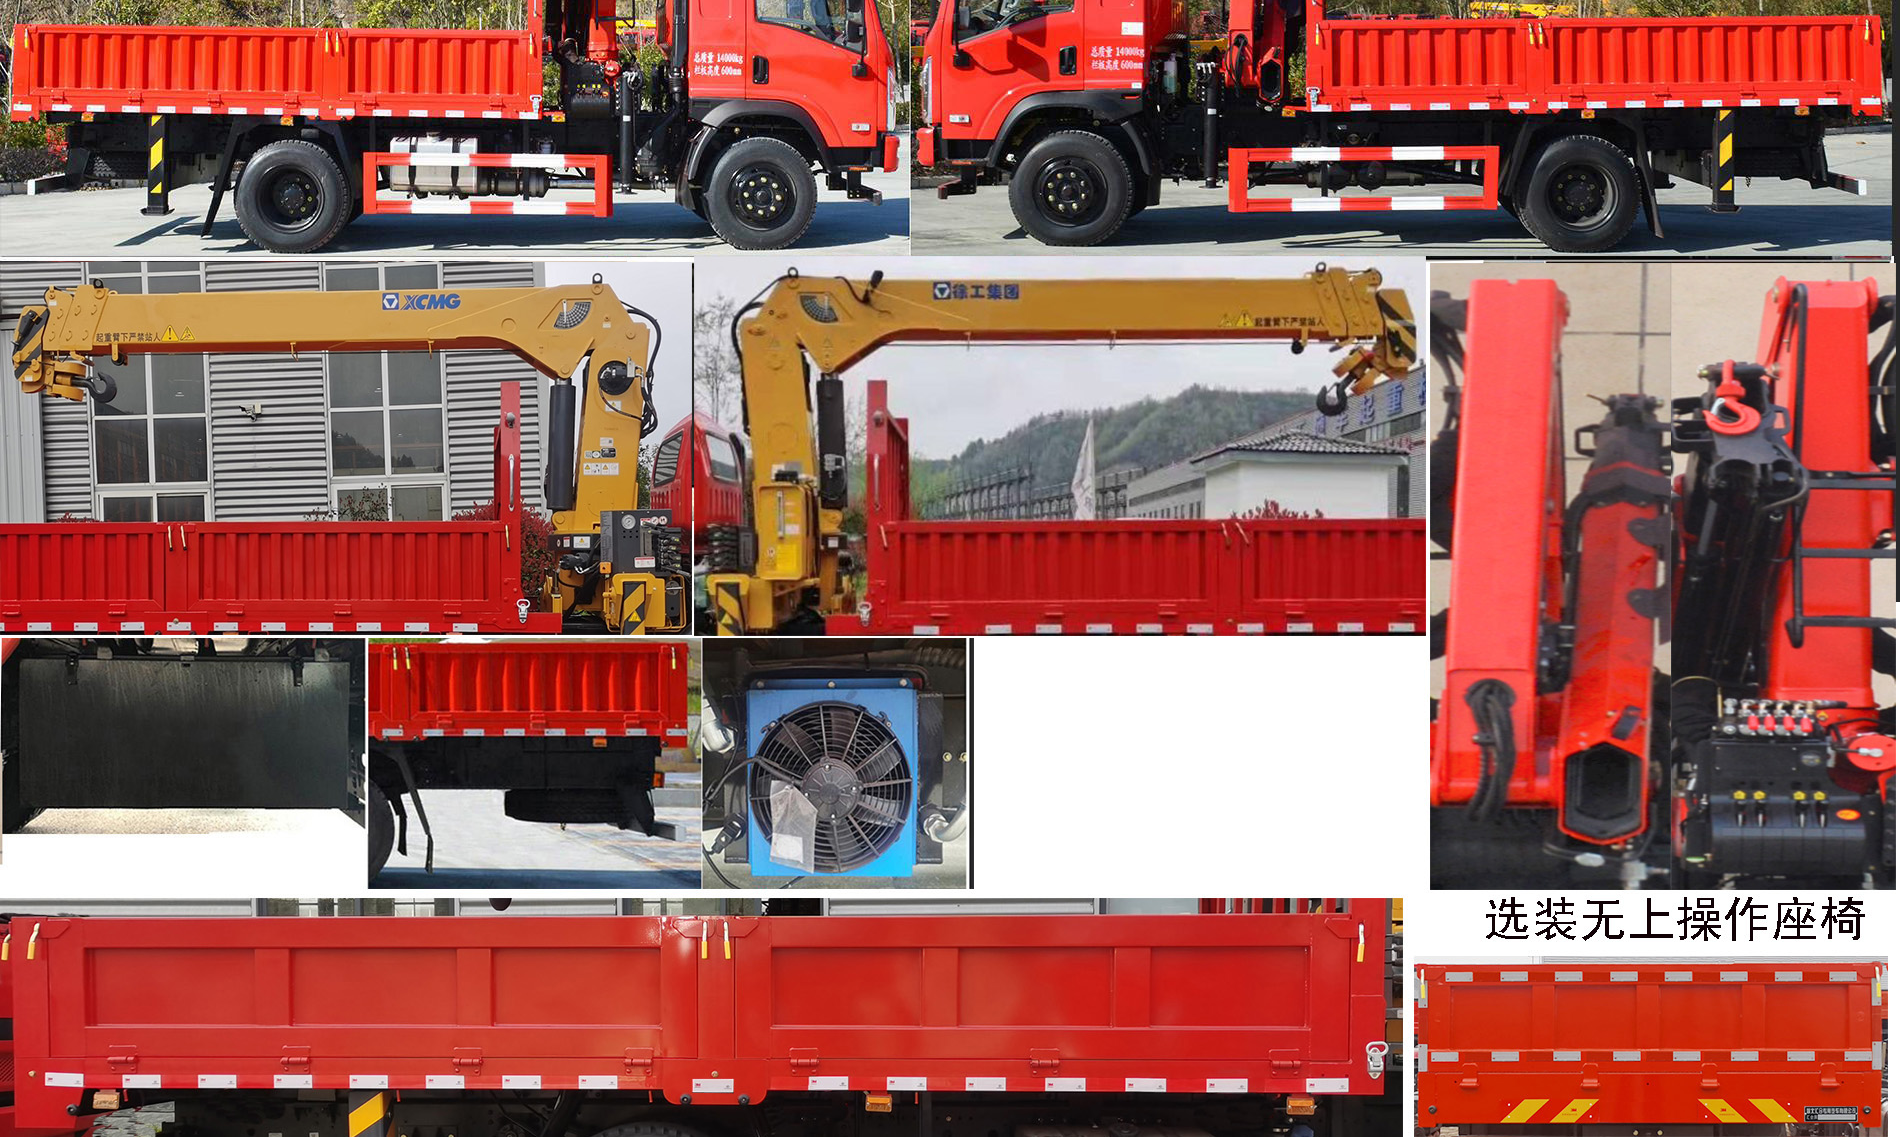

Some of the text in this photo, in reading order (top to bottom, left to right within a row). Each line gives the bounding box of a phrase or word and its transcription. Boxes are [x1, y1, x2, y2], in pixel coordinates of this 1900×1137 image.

[953, 283, 1019, 300] 徐工集团
[400, 293, 461, 310] XCMG
[96, 332, 161, 342] 起重臂下严禁站人
